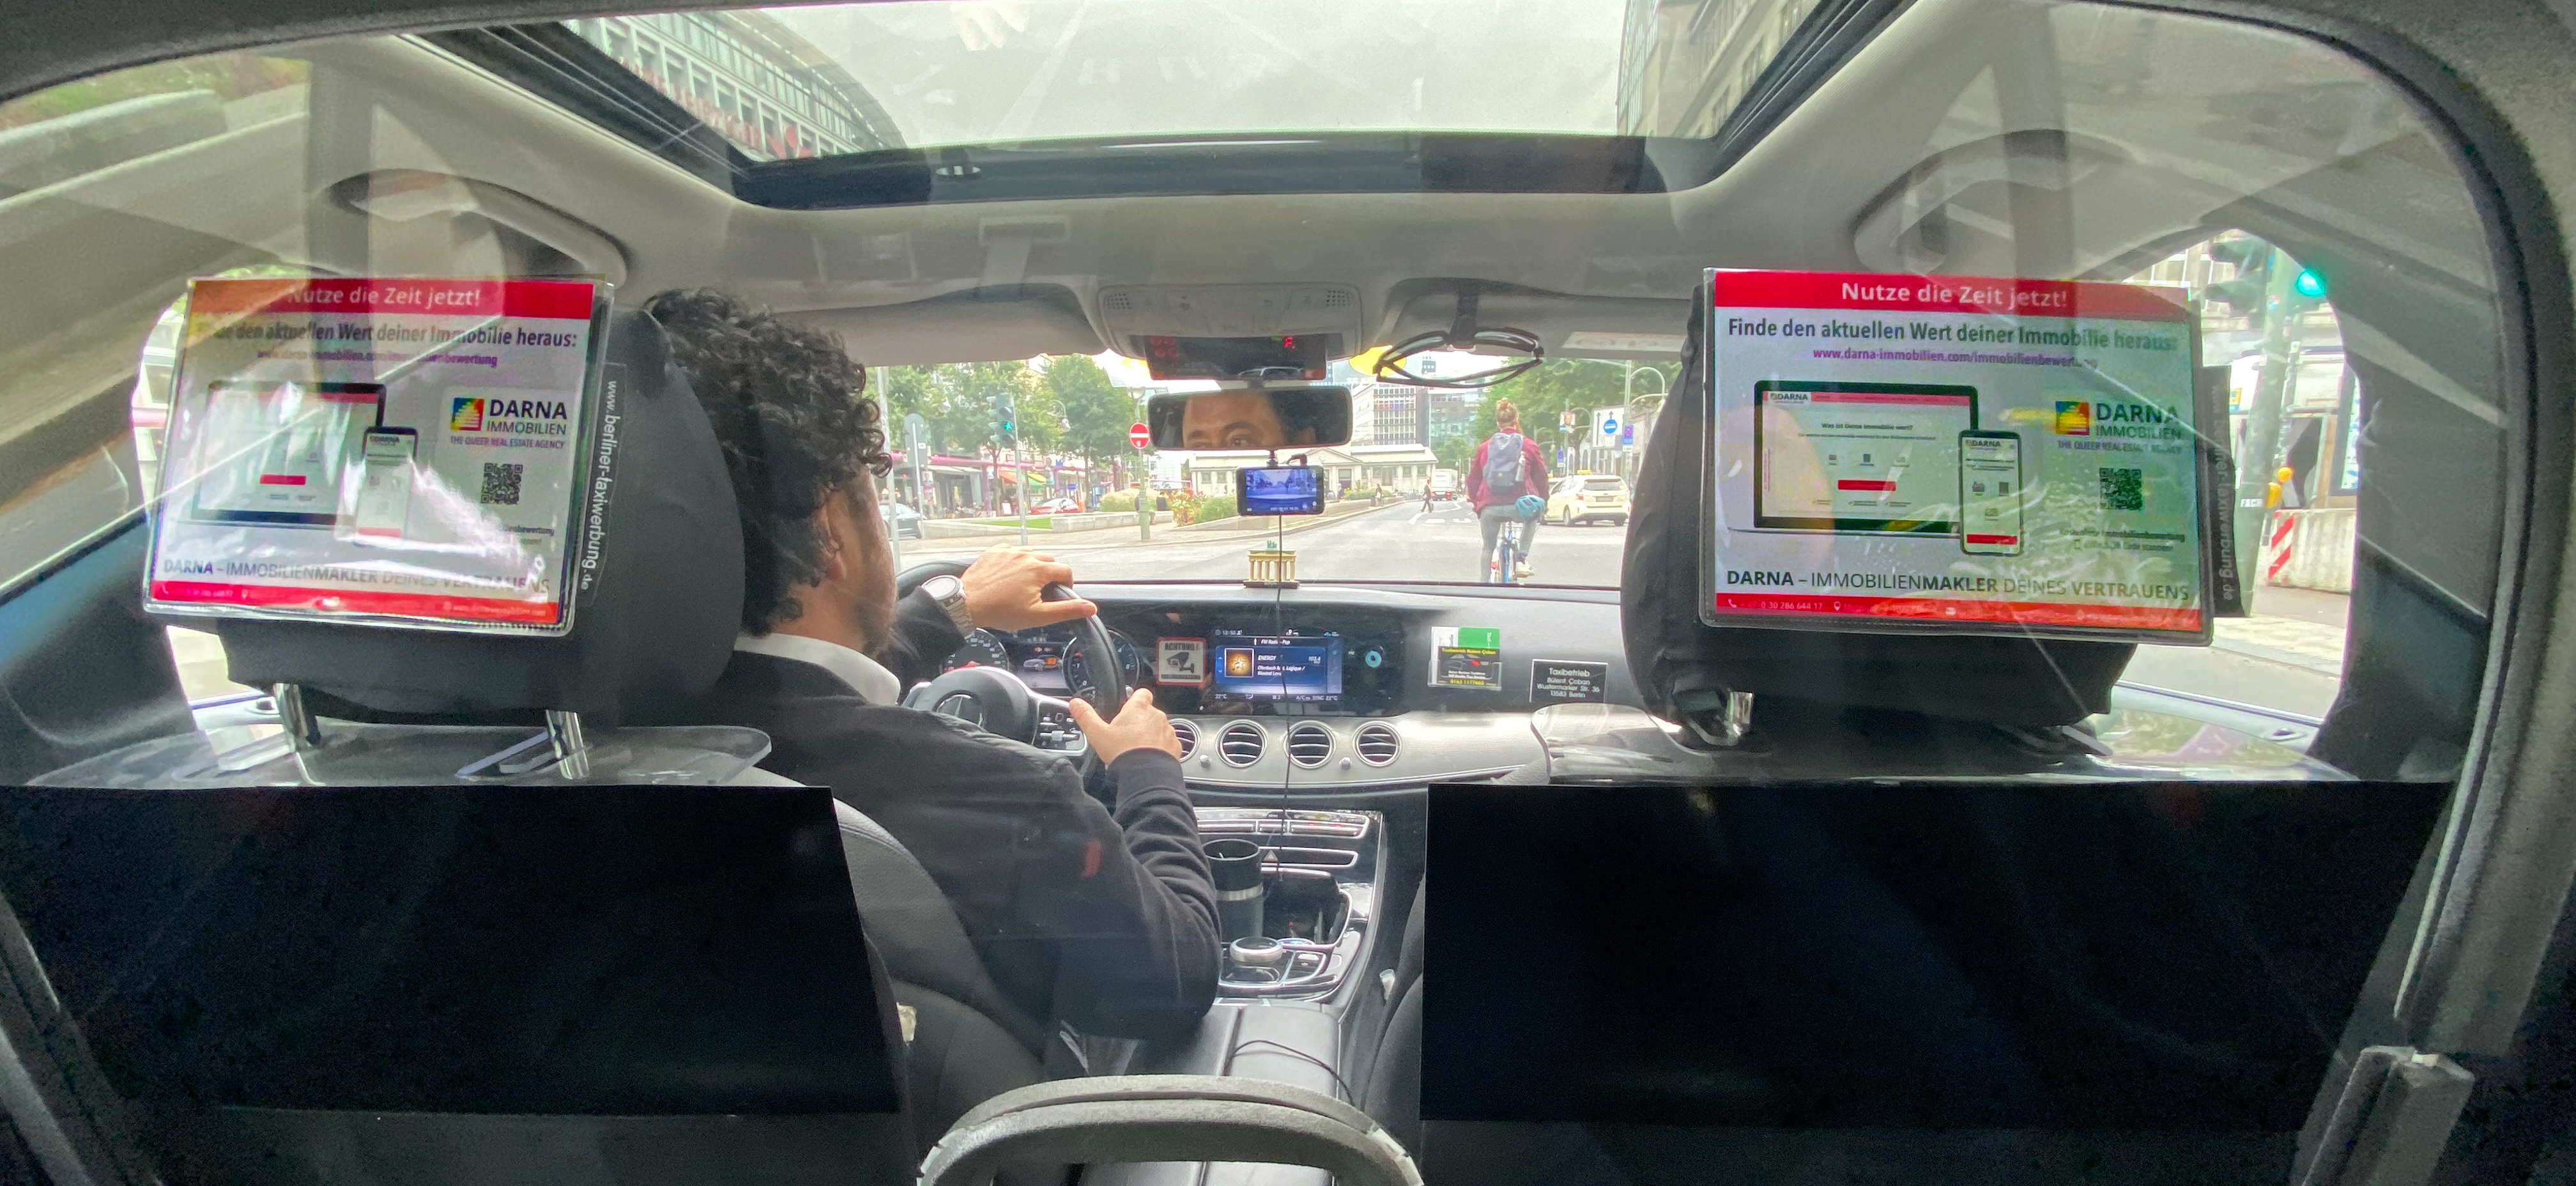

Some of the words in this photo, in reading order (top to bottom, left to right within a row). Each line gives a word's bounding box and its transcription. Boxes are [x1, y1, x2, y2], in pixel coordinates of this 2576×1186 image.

[349, 286, 378, 304] die
[385, 288, 422, 305] Zeit
[425, 288, 480, 310] jetzt!
[1842, 282, 1910, 302] Nutze
[1918, 284, 1952, 303] die
[1959, 286, 2004, 305] Zeit
[2008, 288, 2067, 311] jetzt!
[338, 323, 373, 341] Wert
[376, 323, 427, 341] deiner
[517, 327, 577, 348] heraus:
[1729, 318, 1777, 336] Finde
[1782, 318, 1816, 337] den
[1821, 320, 1905, 340] aktuellen
[1910, 321, 1952, 341] Wert
[1957, 323, 2014, 343] deiner
[2019, 326, 2110, 348] Immobilie
[1813, 347, 2097, 369] www.darna-immobilien.com/immobilienbewert
[489, 399, 567, 420] DARNA
[2096, 403, 2178, 423] DARNA
[487, 420, 567, 435] IMMOBILIEN
[2096, 425, 2181, 440] IMMOBILIEN
[450, 436, 464, 445] THE
[465, 436, 490, 445] QUEER
[491, 437, 509, 447] REAL
[510, 438, 534, 448] ESTATE
[535, 439, 566, 449] AGENCY
[164, 559, 213, 574] DARNA
[1727, 570, 1794, 586] DARNA
[1812, 573, 1998, 592] IMMOBILIENMAKLER
[2004, 578, 2066, 596] DEINES
[2072, 581, 2188, 601] VERTRAUENS
[1780, 602, 1794, 610] 286
[1549, 667, 1590, 677] Taxibetrieb
